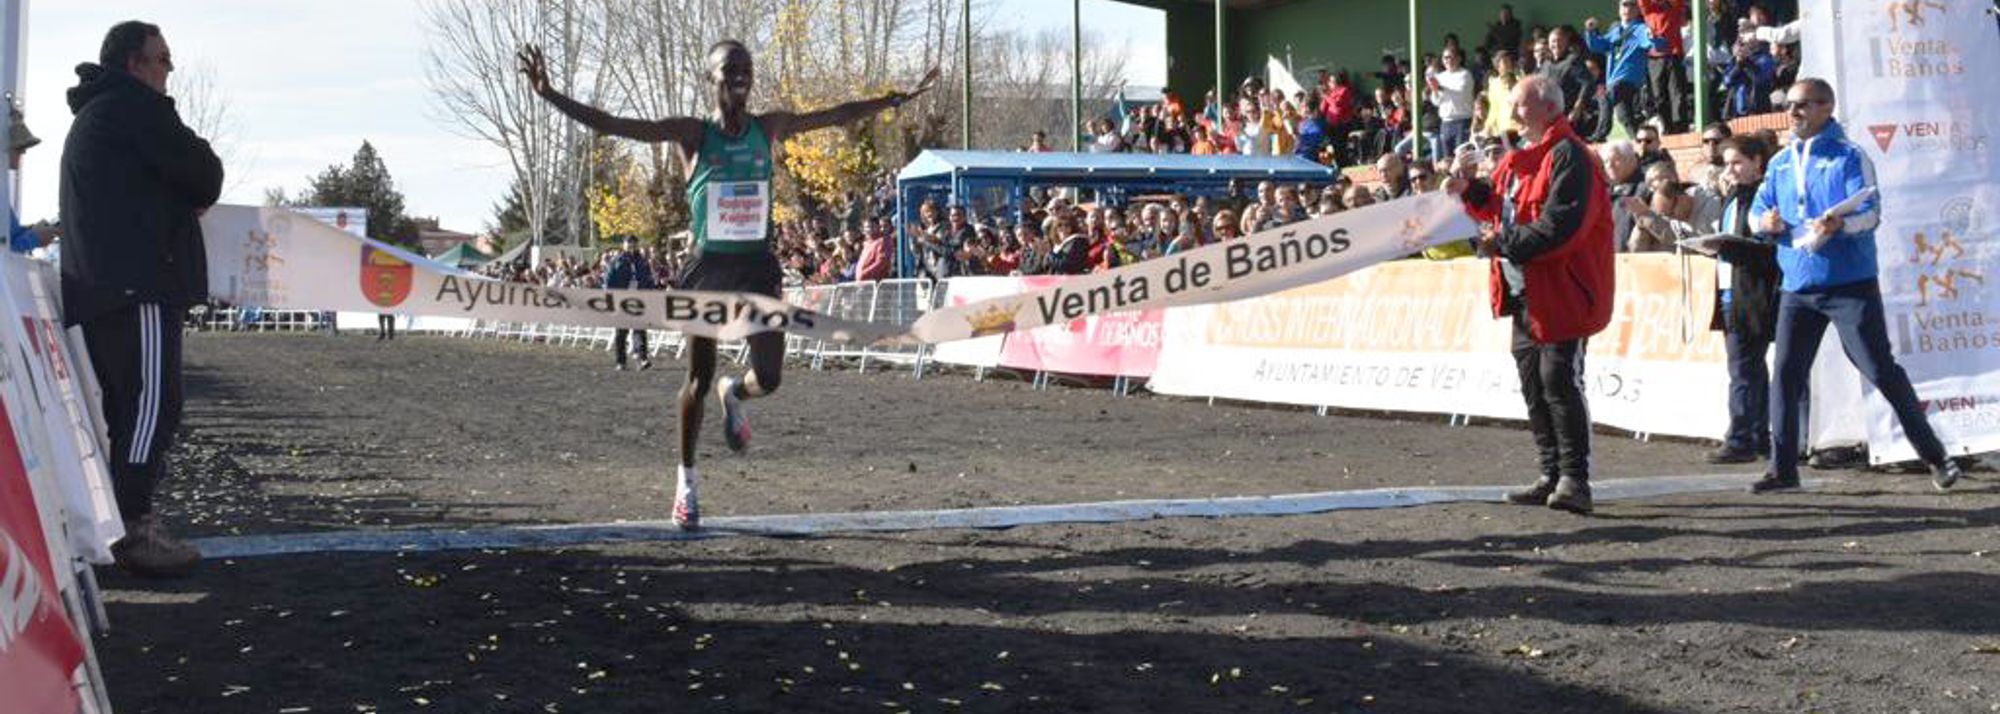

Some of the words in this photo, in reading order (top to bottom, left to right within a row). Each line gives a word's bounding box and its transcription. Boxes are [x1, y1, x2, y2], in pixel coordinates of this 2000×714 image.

[1037, 275, 1150, 325] Venta
[1165, 257, 1211, 294] de
[1226, 226, 1351, 280] Baños
[586, 293, 646, 317] de
[1915, 309, 1984, 331] Venta
[1254, 358, 1389, 387] AYUNTAMIENTO
[1394, 366, 1425, 388] DE
